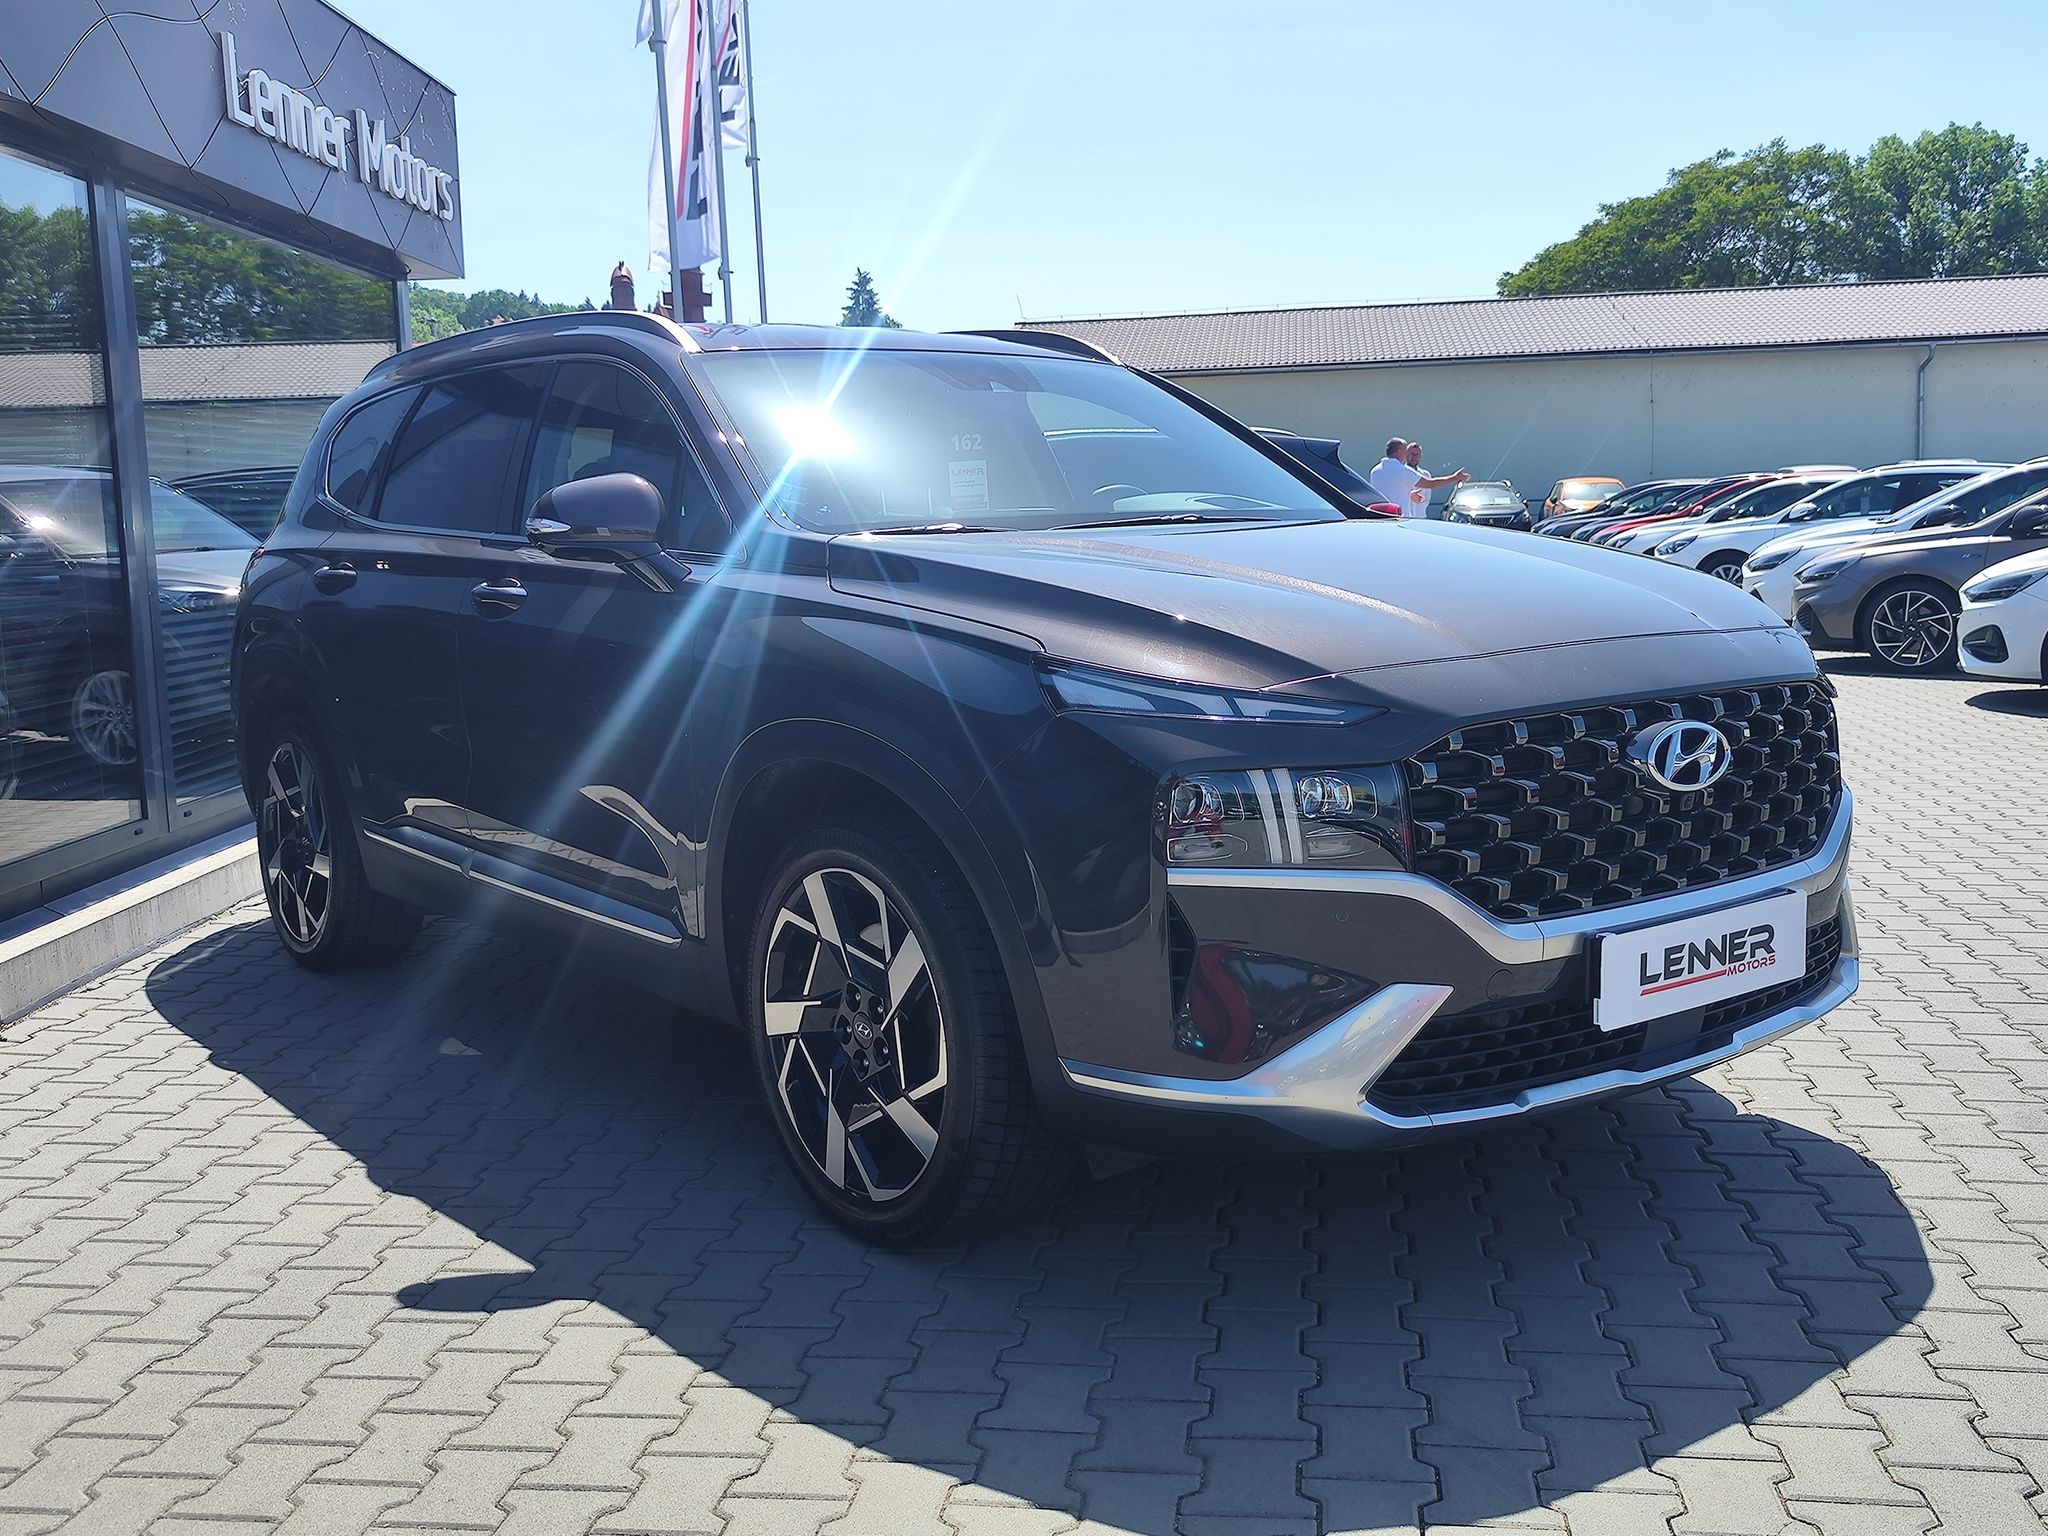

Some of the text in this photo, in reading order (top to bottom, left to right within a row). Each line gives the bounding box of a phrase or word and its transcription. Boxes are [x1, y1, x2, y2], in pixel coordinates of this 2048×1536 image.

[221, 31, 453, 221] Lenner Motors
[950, 433, 983, 451] 162
[1640, 923, 1775, 986] LENNER
[1726, 954, 1776, 976] MOTORS
